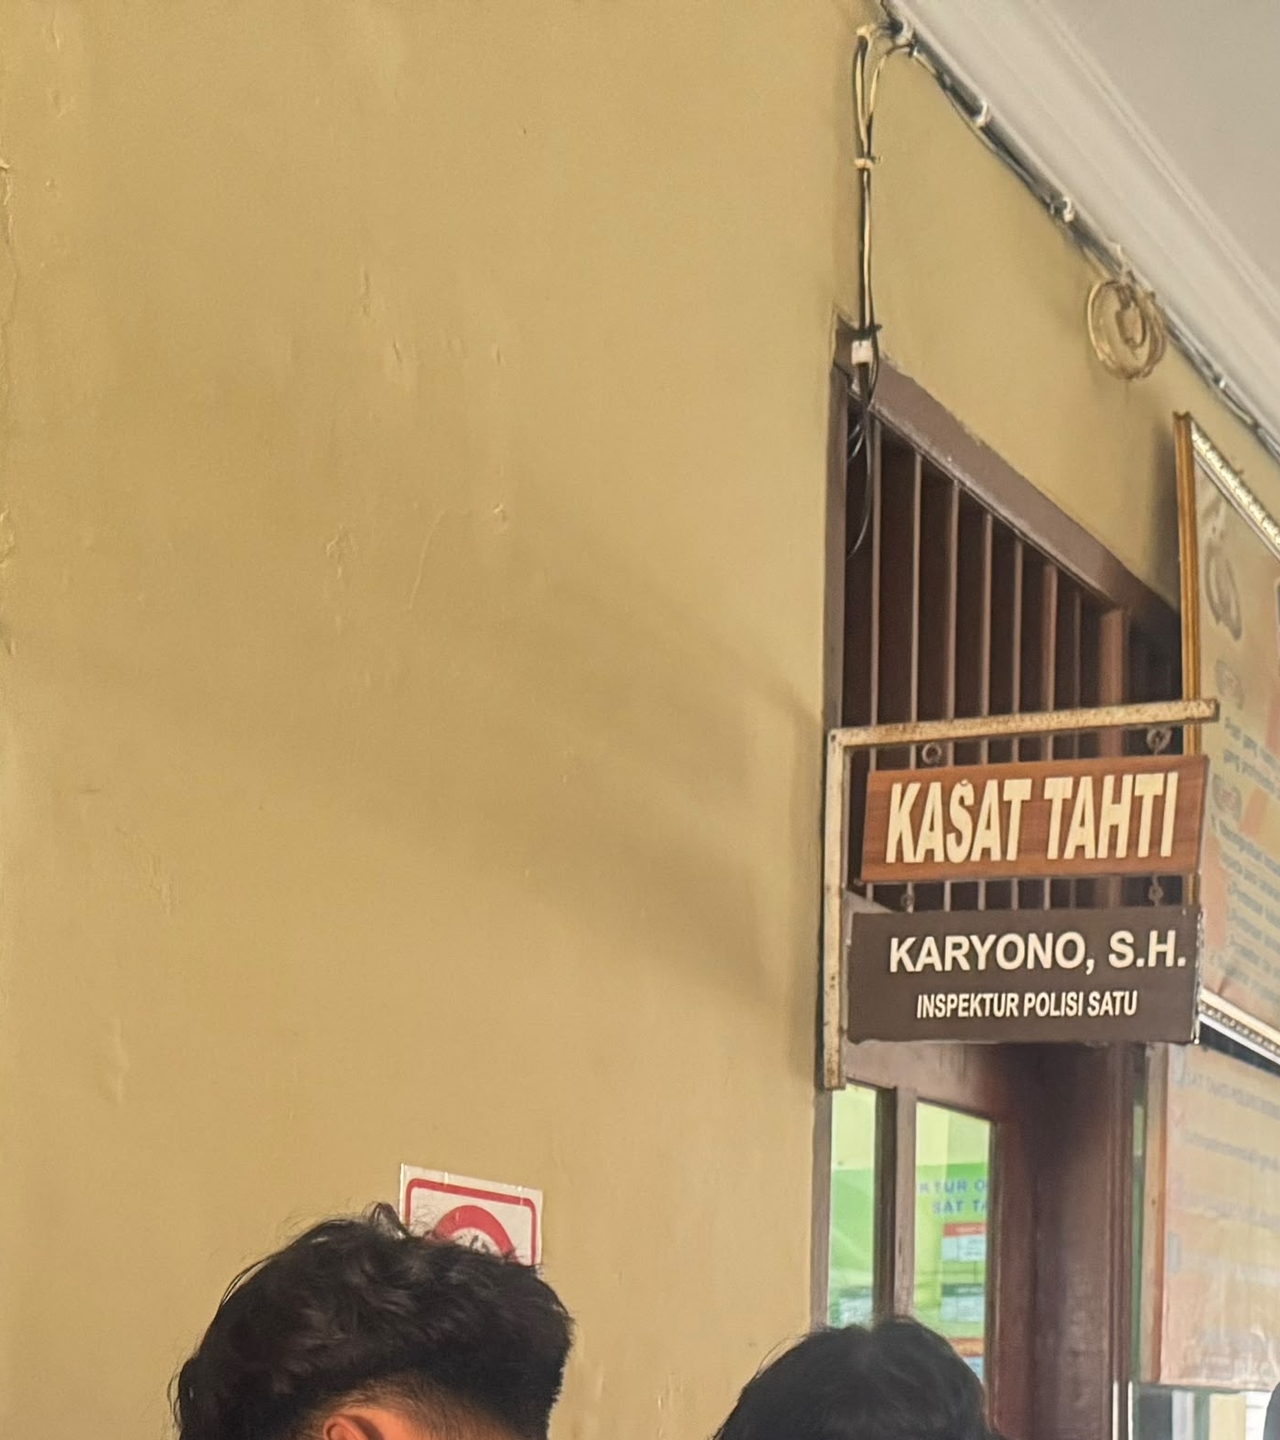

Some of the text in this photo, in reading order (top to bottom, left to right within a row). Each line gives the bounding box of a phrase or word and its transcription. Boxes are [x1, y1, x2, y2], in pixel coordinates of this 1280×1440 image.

[885, 777, 1033, 864] KASAT
[1043, 771, 1179, 860] TAHTI
[888, 931, 1095, 975] KARYONO,
[1108, 929, 1187, 968] S.H.
[916, 990, 1138, 1019] INSPEKTUR POLISI SATU
